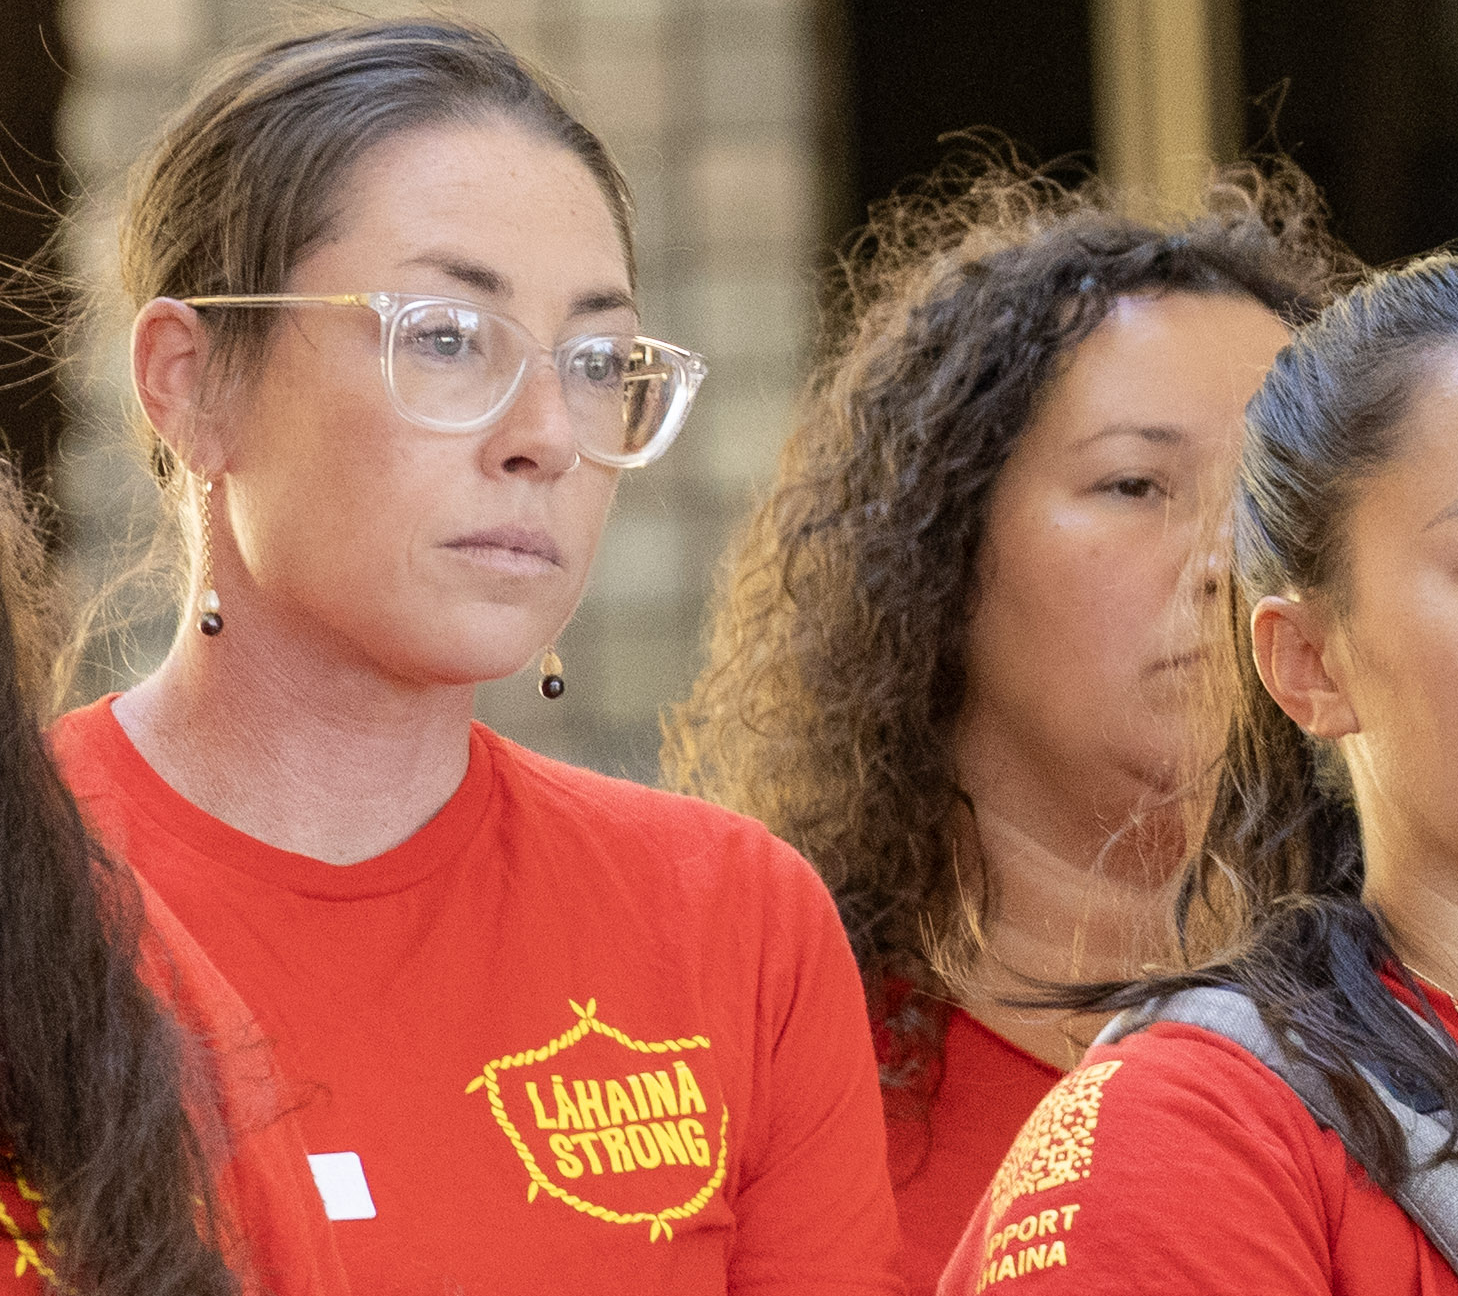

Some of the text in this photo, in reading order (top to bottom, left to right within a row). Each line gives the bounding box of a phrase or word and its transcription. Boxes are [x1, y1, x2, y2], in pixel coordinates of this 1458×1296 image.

[549, 1118, 711, 1179] STRONG
[987, 1203, 1081, 1260] PPORT
[976, 1240, 1067, 1295] HAINA
